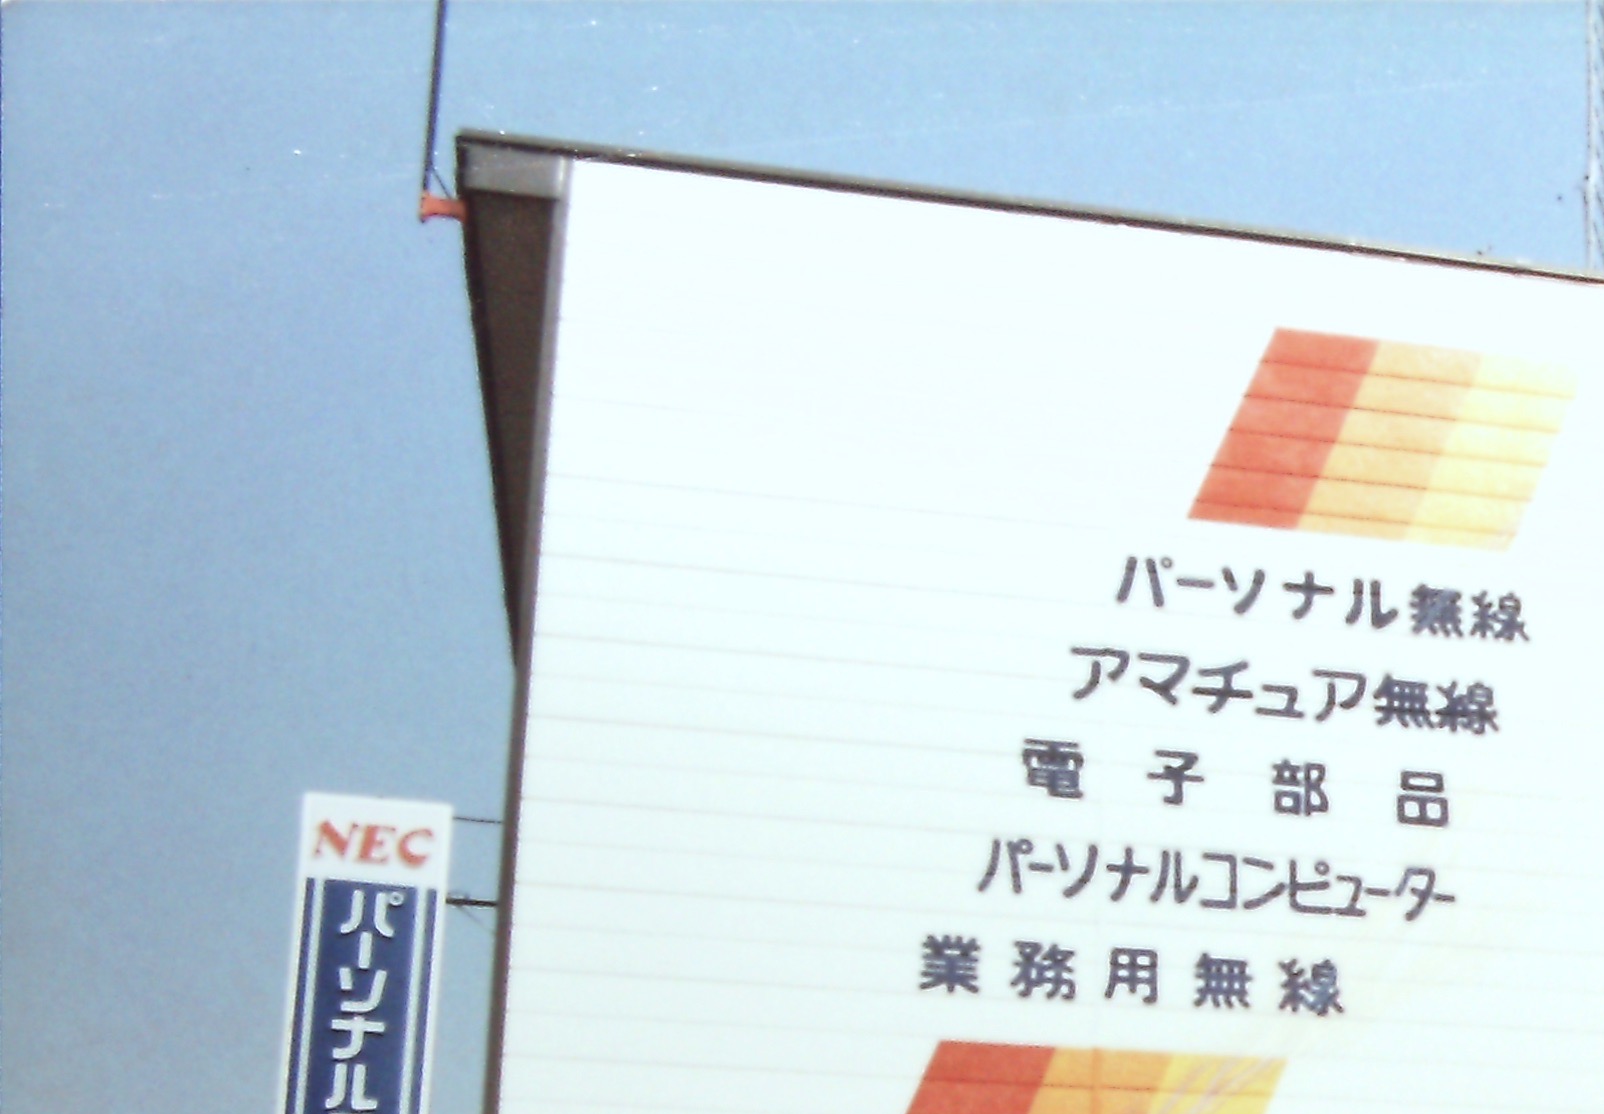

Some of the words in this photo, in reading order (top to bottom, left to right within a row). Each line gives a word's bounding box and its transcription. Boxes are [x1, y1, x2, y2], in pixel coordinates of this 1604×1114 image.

[1115, 555, 1531, 643] パーソナル無線
[1069, 646, 1500, 736] アマチュア無線
[1020, 737, 1450, 829] 電子部品
[312, 819, 436, 868] NEC
[976, 837, 1457, 923] パーソナルコンピューター
[917, 933, 1346, 1018] 業務用無線
